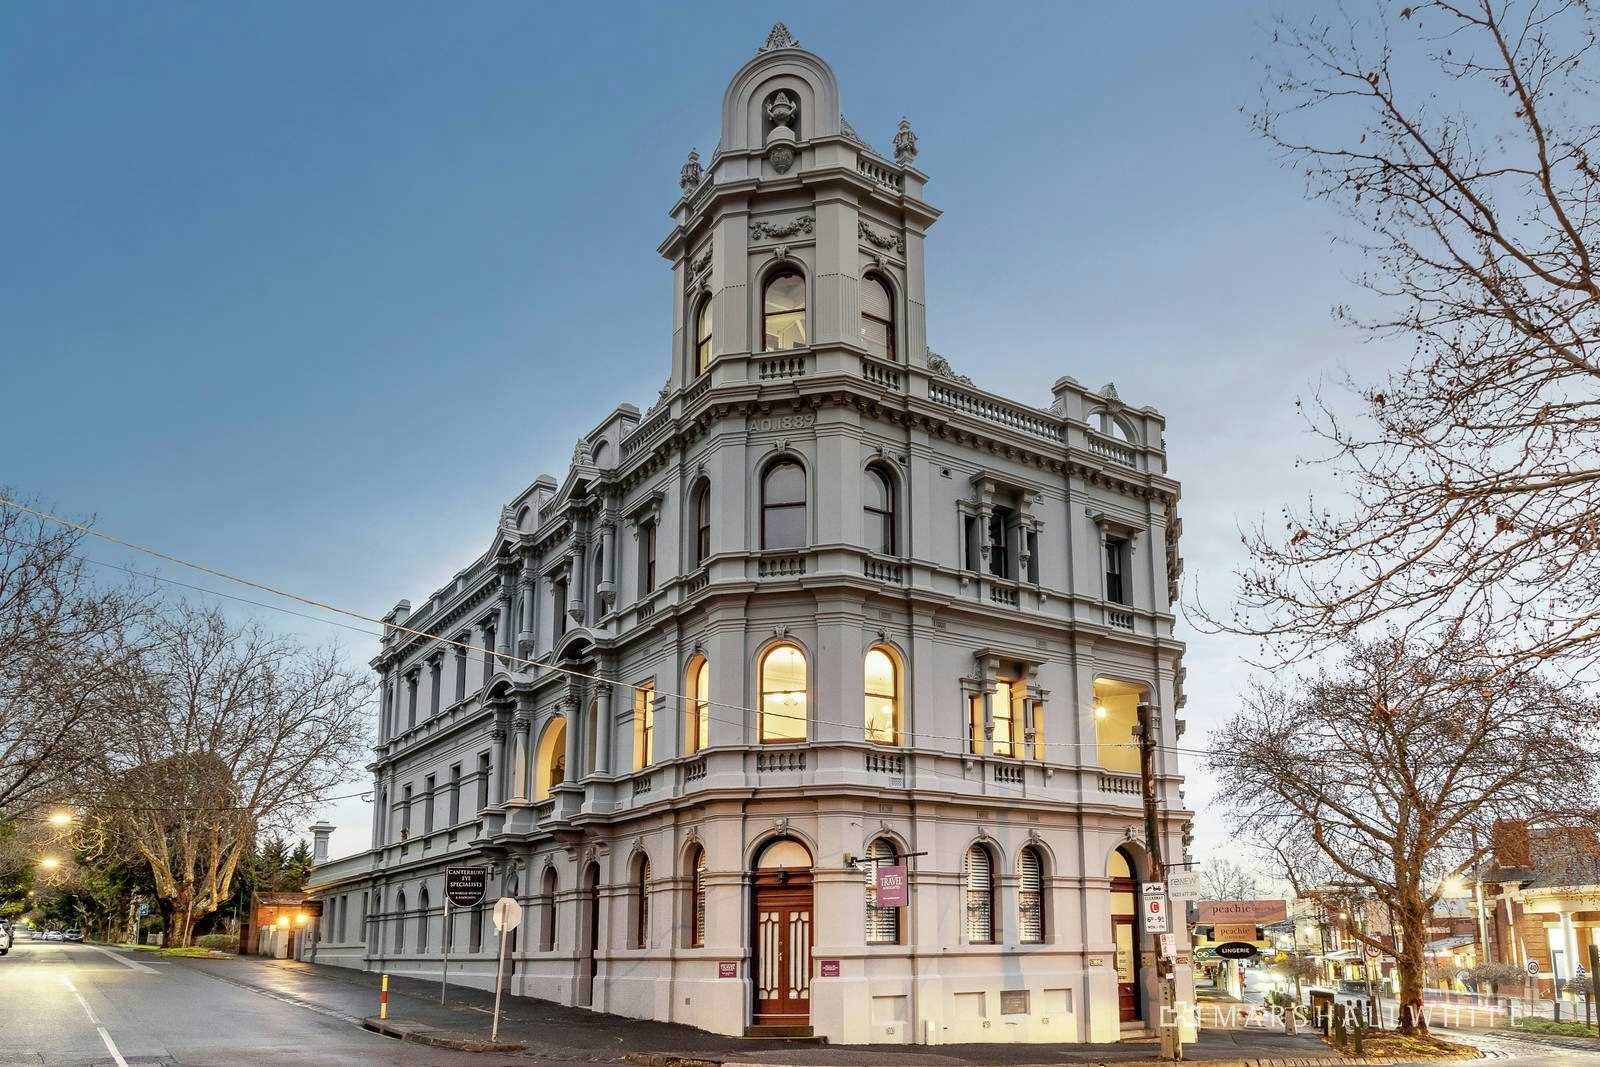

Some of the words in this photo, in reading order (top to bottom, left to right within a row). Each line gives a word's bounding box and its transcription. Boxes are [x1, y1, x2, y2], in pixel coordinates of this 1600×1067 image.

[880, 876, 902, 887] TRAVEL
[1212, 904, 1251, 916] peachie
[1220, 927, 1250, 935] peachie
